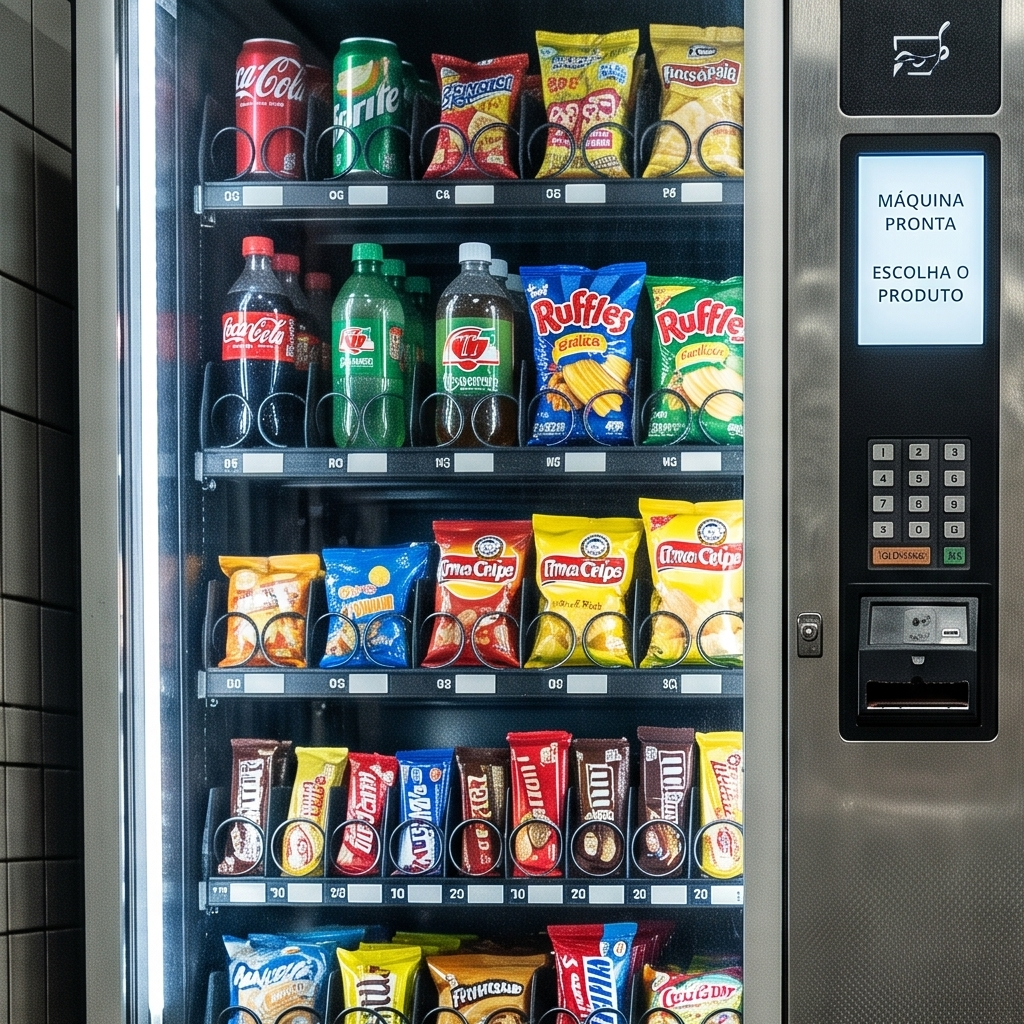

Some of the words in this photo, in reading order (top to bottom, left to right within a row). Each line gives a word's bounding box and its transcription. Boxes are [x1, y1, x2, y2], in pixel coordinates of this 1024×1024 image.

[878, 190, 964, 211] MÁQUINA
[886, 217, 956, 231] PRONTA
[873, 266, 951, 280] ESCOLHA
[957, 266, 969, 280] O
[879, 289, 964, 303] PRODUTO
[532, 289, 633, 335] Ruffles
[657, 299, 743, 344] Ruffle
[916, 447, 922, 456] 2
[952, 448, 958, 457] 3
[880, 474, 886, 483] 4
[916, 474, 922, 483] 5
[951, 474, 957, 483] 6
[880, 499, 886, 508] 7
[951, 500, 957, 509] 9
[880, 526, 886, 534] 3
[450, 888, 464, 899] 20
[571, 889, 586, 899] 20
[633, 889, 646, 900] 20
[694, 889, 708, 899] 20
